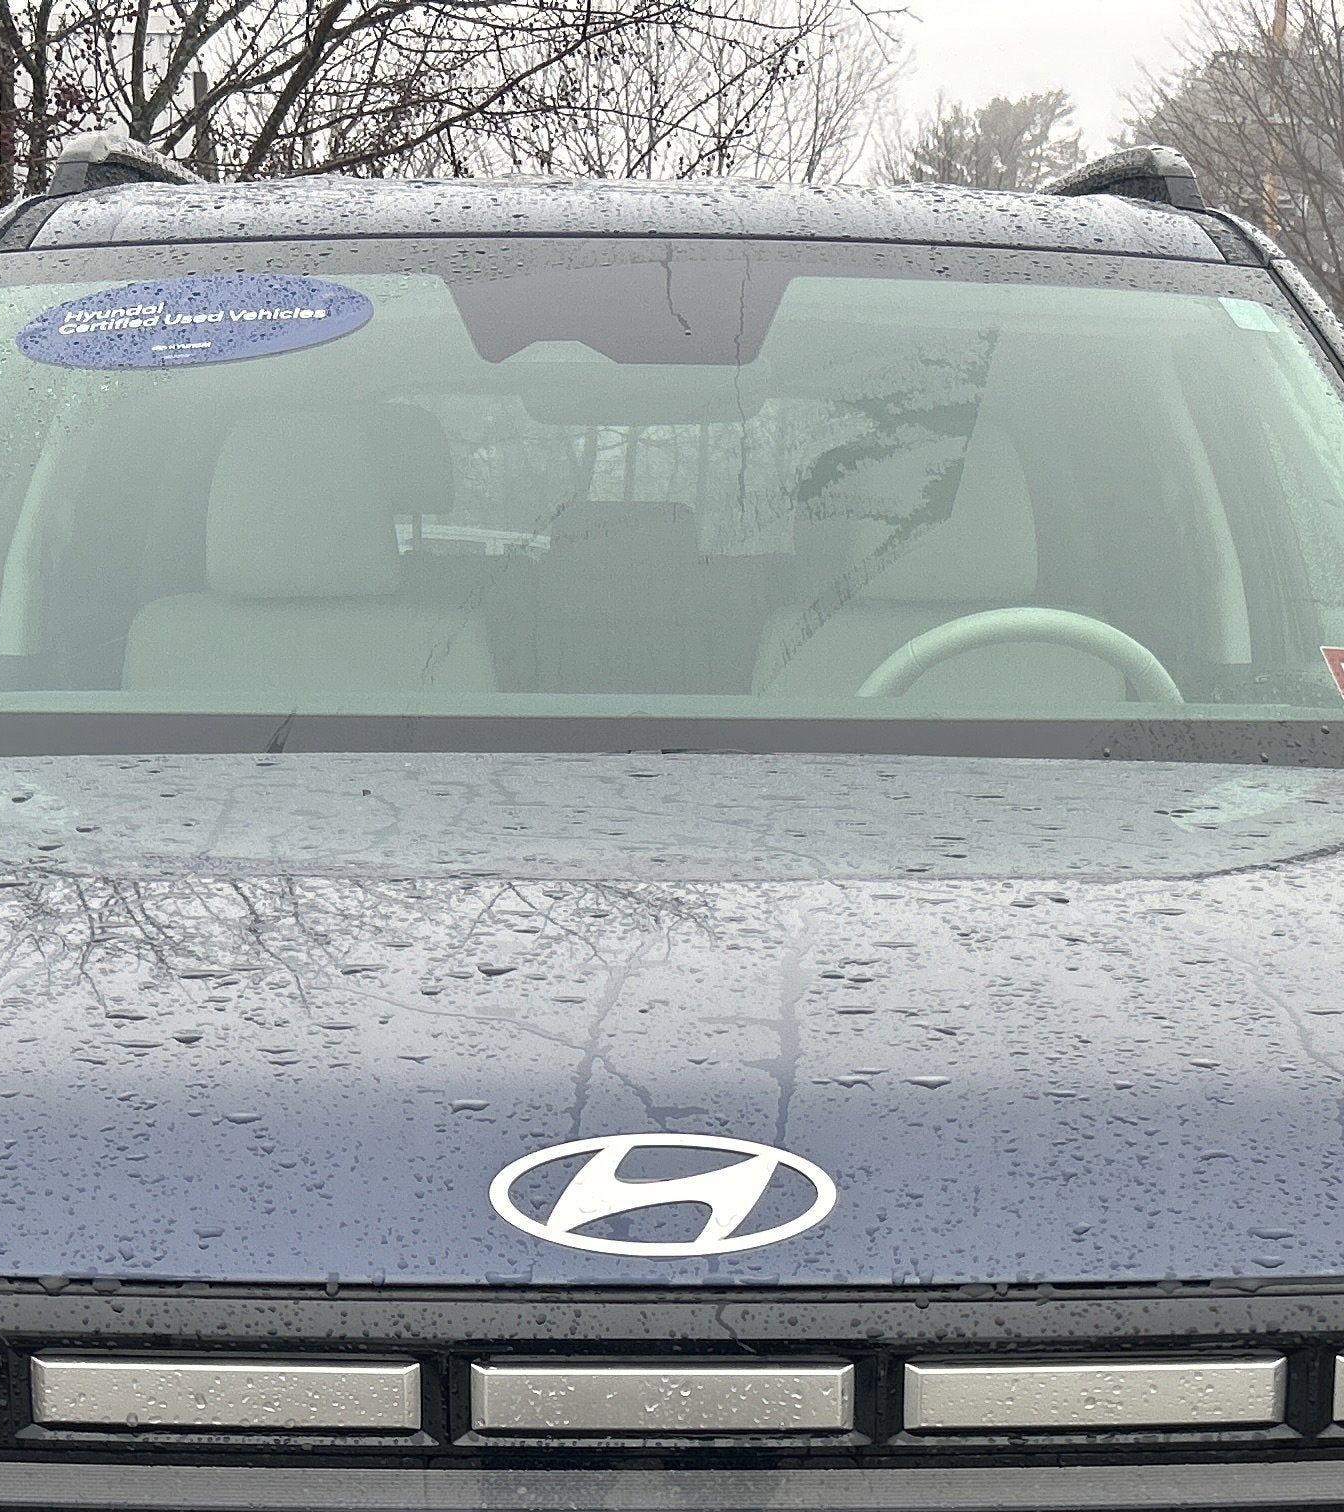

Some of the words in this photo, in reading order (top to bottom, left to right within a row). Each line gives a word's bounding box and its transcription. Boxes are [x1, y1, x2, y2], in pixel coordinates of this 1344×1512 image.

[58, 315, 159, 335] Certified
[165, 311, 223, 325] Used
[230, 307, 326, 321] Vehicles
[64, 302, 164, 324] Hyundai
